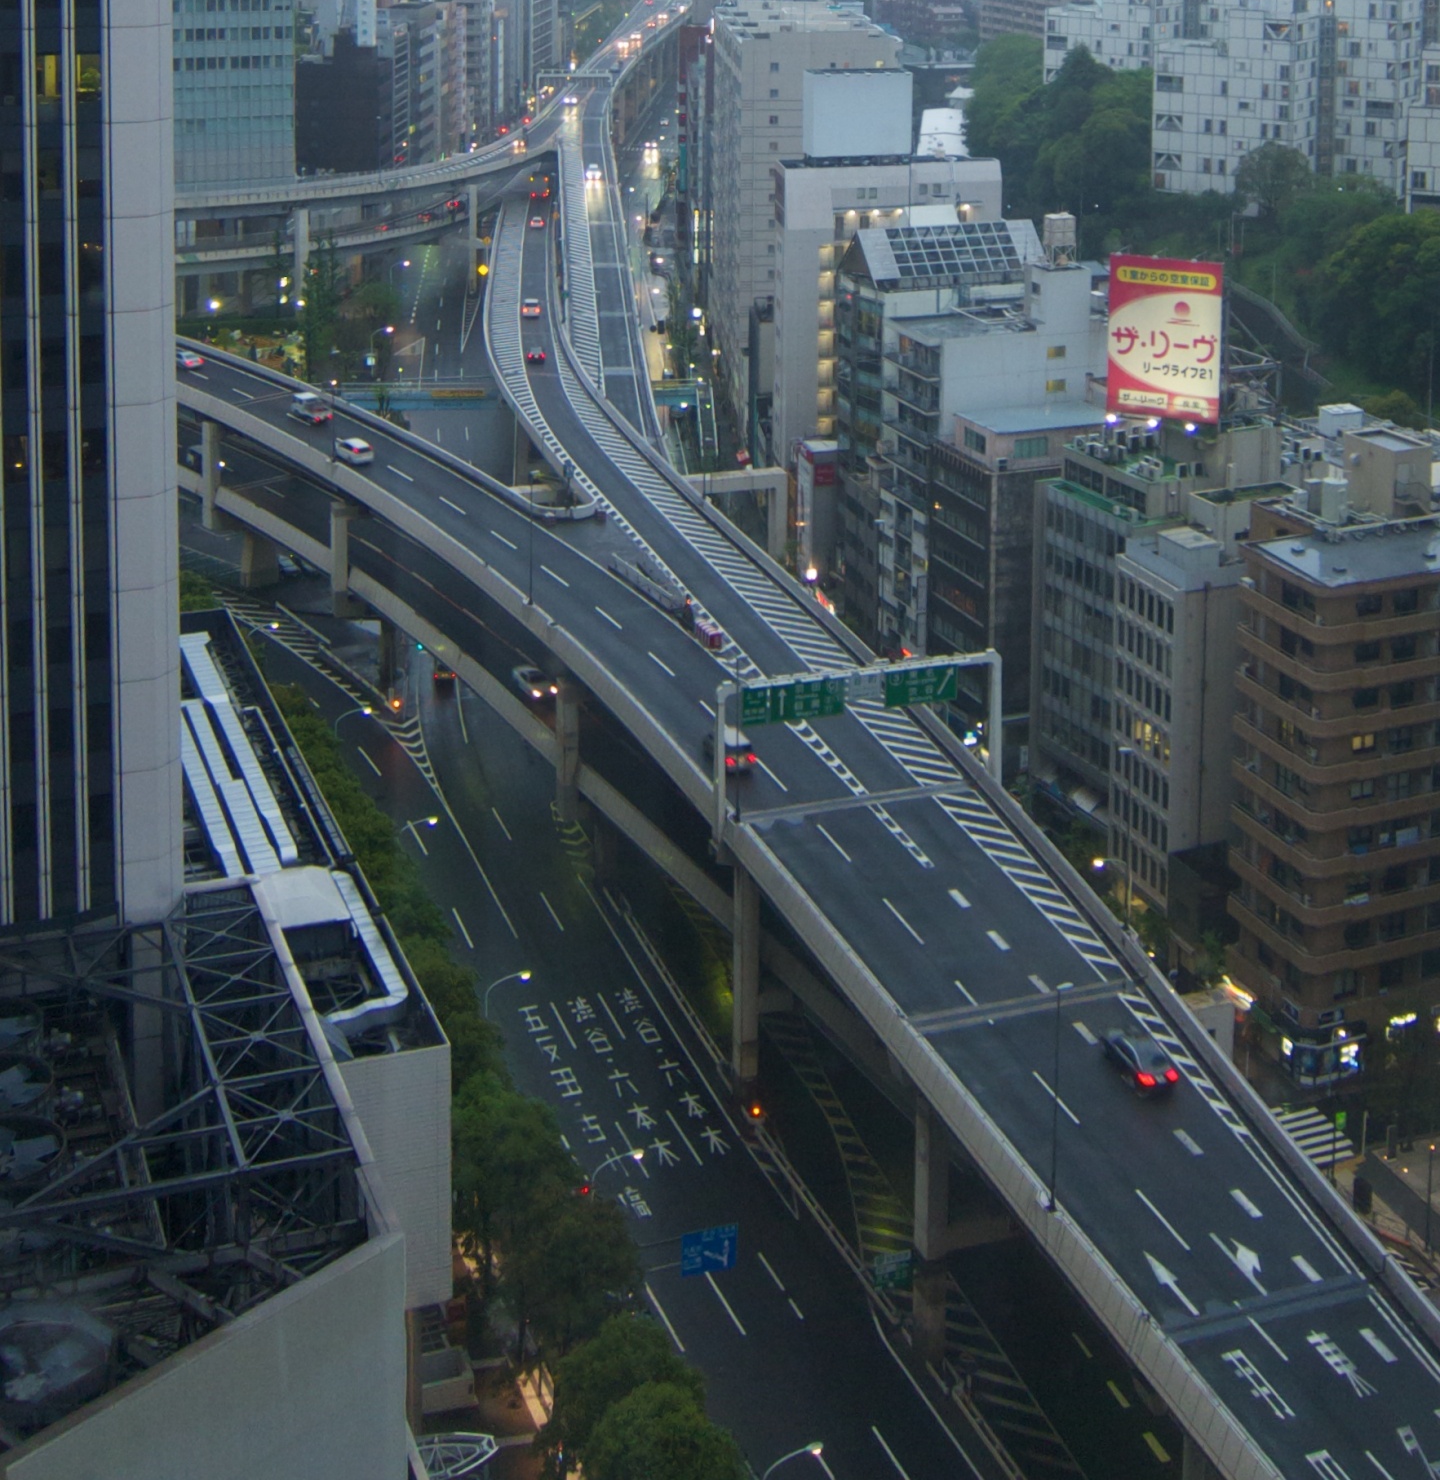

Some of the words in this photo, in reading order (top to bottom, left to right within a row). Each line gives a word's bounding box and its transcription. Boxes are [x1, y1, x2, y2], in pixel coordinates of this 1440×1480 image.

[1111, 326, 1218, 363] ザ・リーヴ
